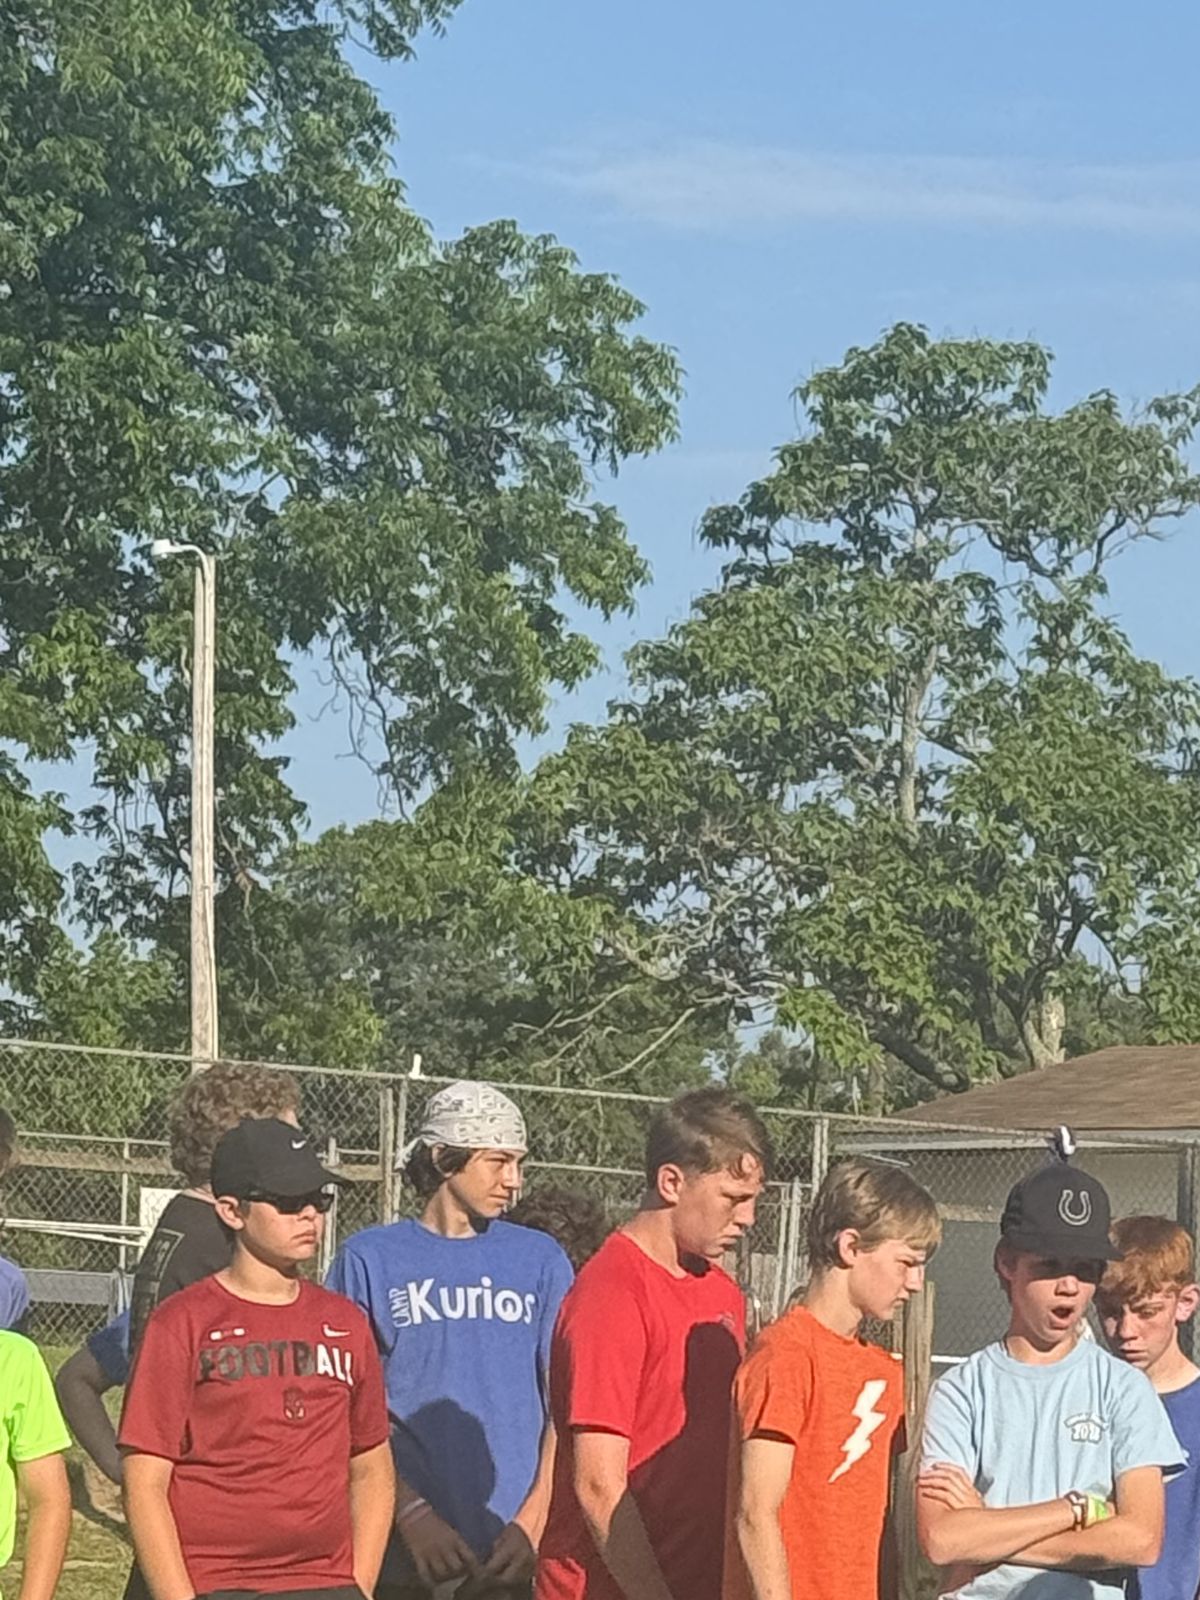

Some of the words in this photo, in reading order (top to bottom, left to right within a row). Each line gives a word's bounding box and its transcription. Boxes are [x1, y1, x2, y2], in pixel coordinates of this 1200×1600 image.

[388, 1287, 413, 1328] CAMP
[406, 1276, 536, 1325] Kurios
[199, 1340, 354, 1387] FOOTBALL
